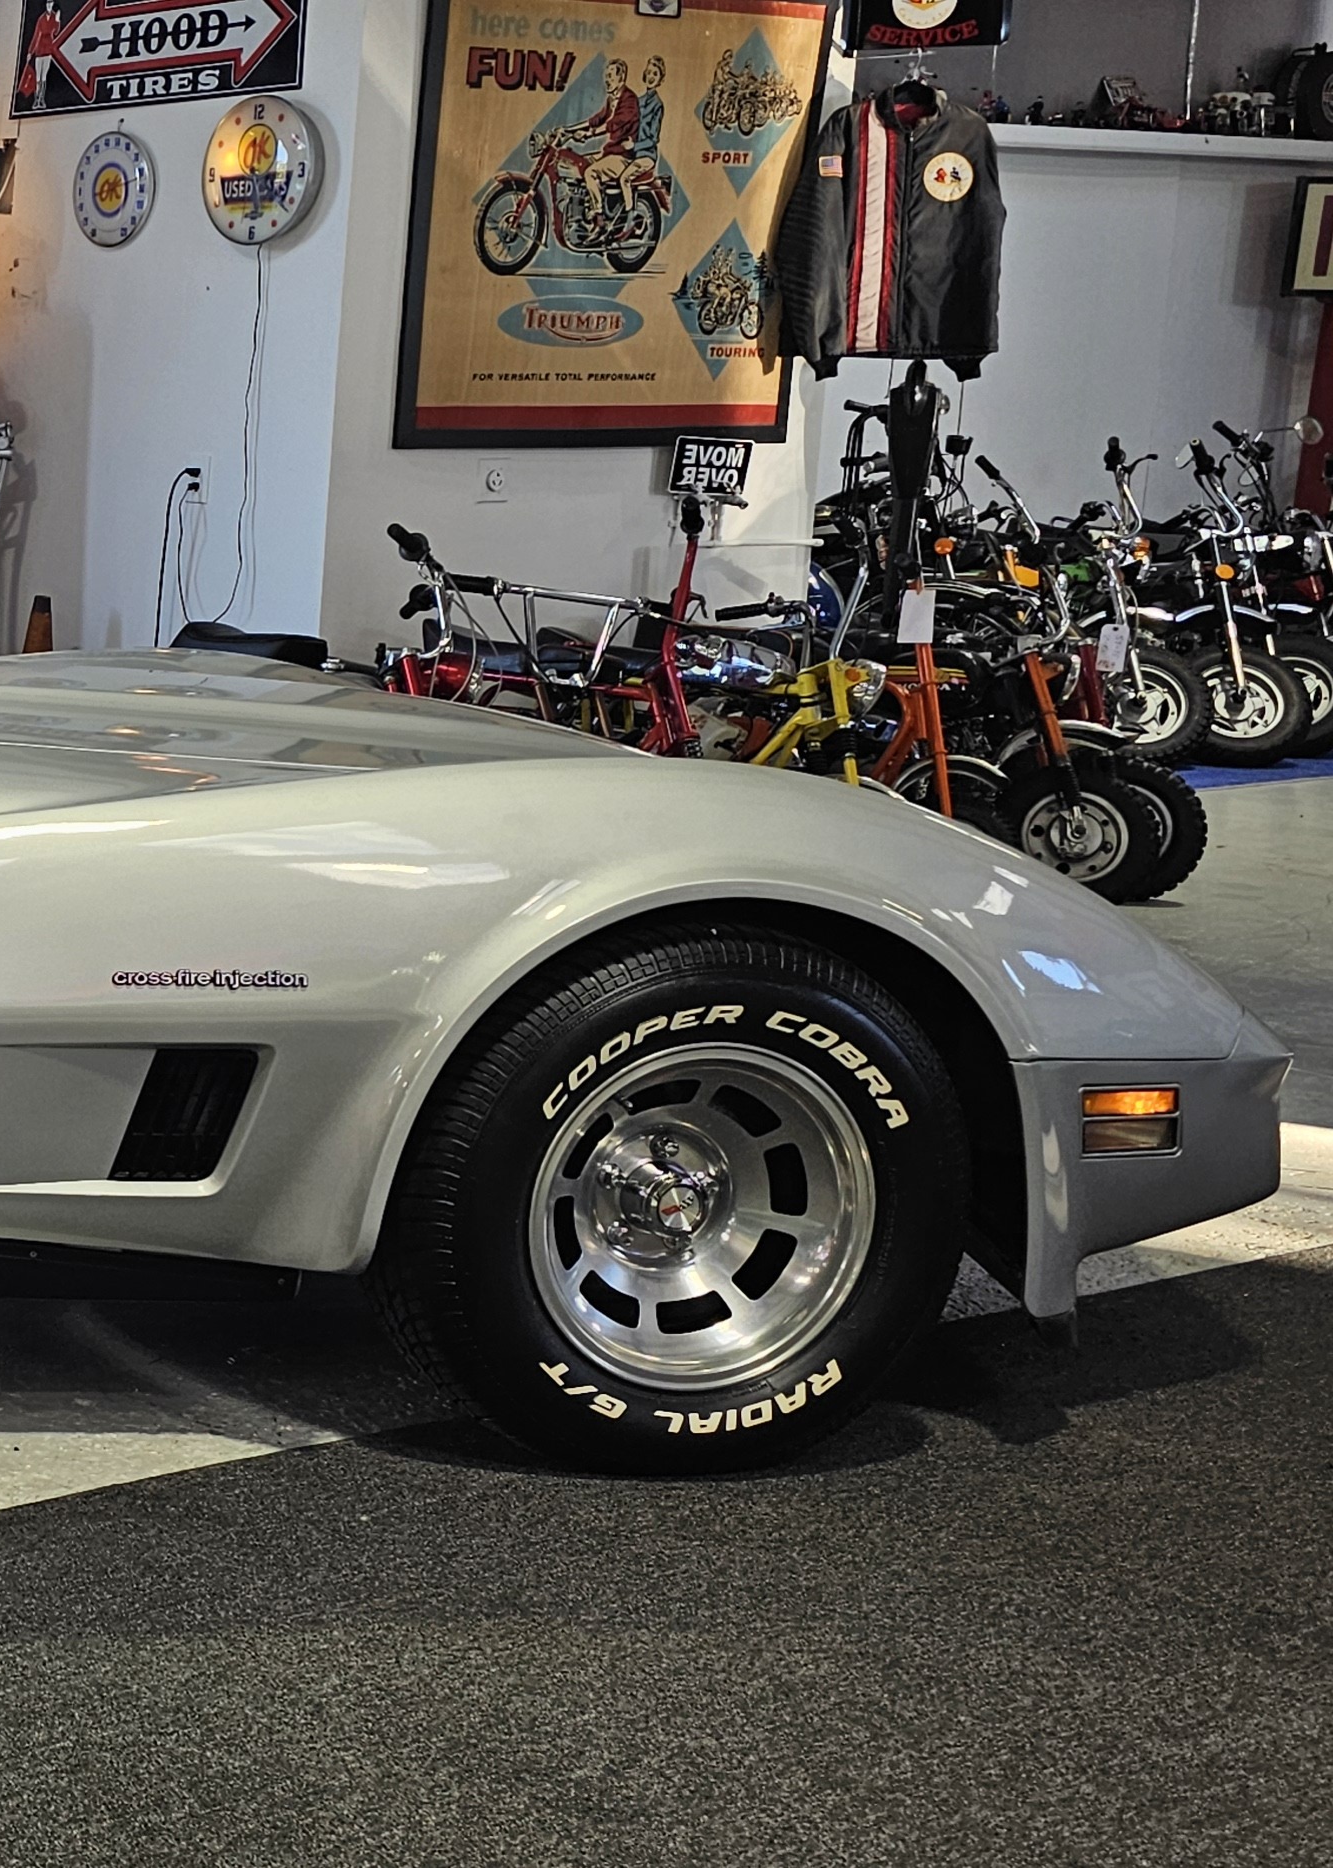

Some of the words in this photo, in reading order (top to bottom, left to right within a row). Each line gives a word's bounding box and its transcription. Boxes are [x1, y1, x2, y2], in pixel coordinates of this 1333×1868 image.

[107, 9, 229, 60] HOOD
[470, 5, 530, 39] here
[538, 17, 617, 44] comes
[867, 19, 979, 46] SERVICE
[466, 46, 576, 91] FUN!
[106, 69, 220, 99] TIRES
[253, 104, 265, 120] 12
[243, 130, 272, 169] OK
[701, 152, 749, 164] SPORT
[224, 180, 253, 198] USED
[248, 226, 255, 240] 6
[524, 305, 625, 330] TRIUMPH
[709, 346, 765, 358] TOURING
[472, 373, 494, 381] FOR
[498, 373, 551, 381] VERSATILE
[555, 373, 583, 381] TOTAL
[587, 373, 657, 381] PERFORMANCE
[214, 969, 308, 990] injection
[542, 1004, 744, 1120] COOPER
[765, 1010, 910, 1130] COBRA
[539, 1361, 628, 1420] G/T
[653, 1358, 843, 1434] RADIAL
